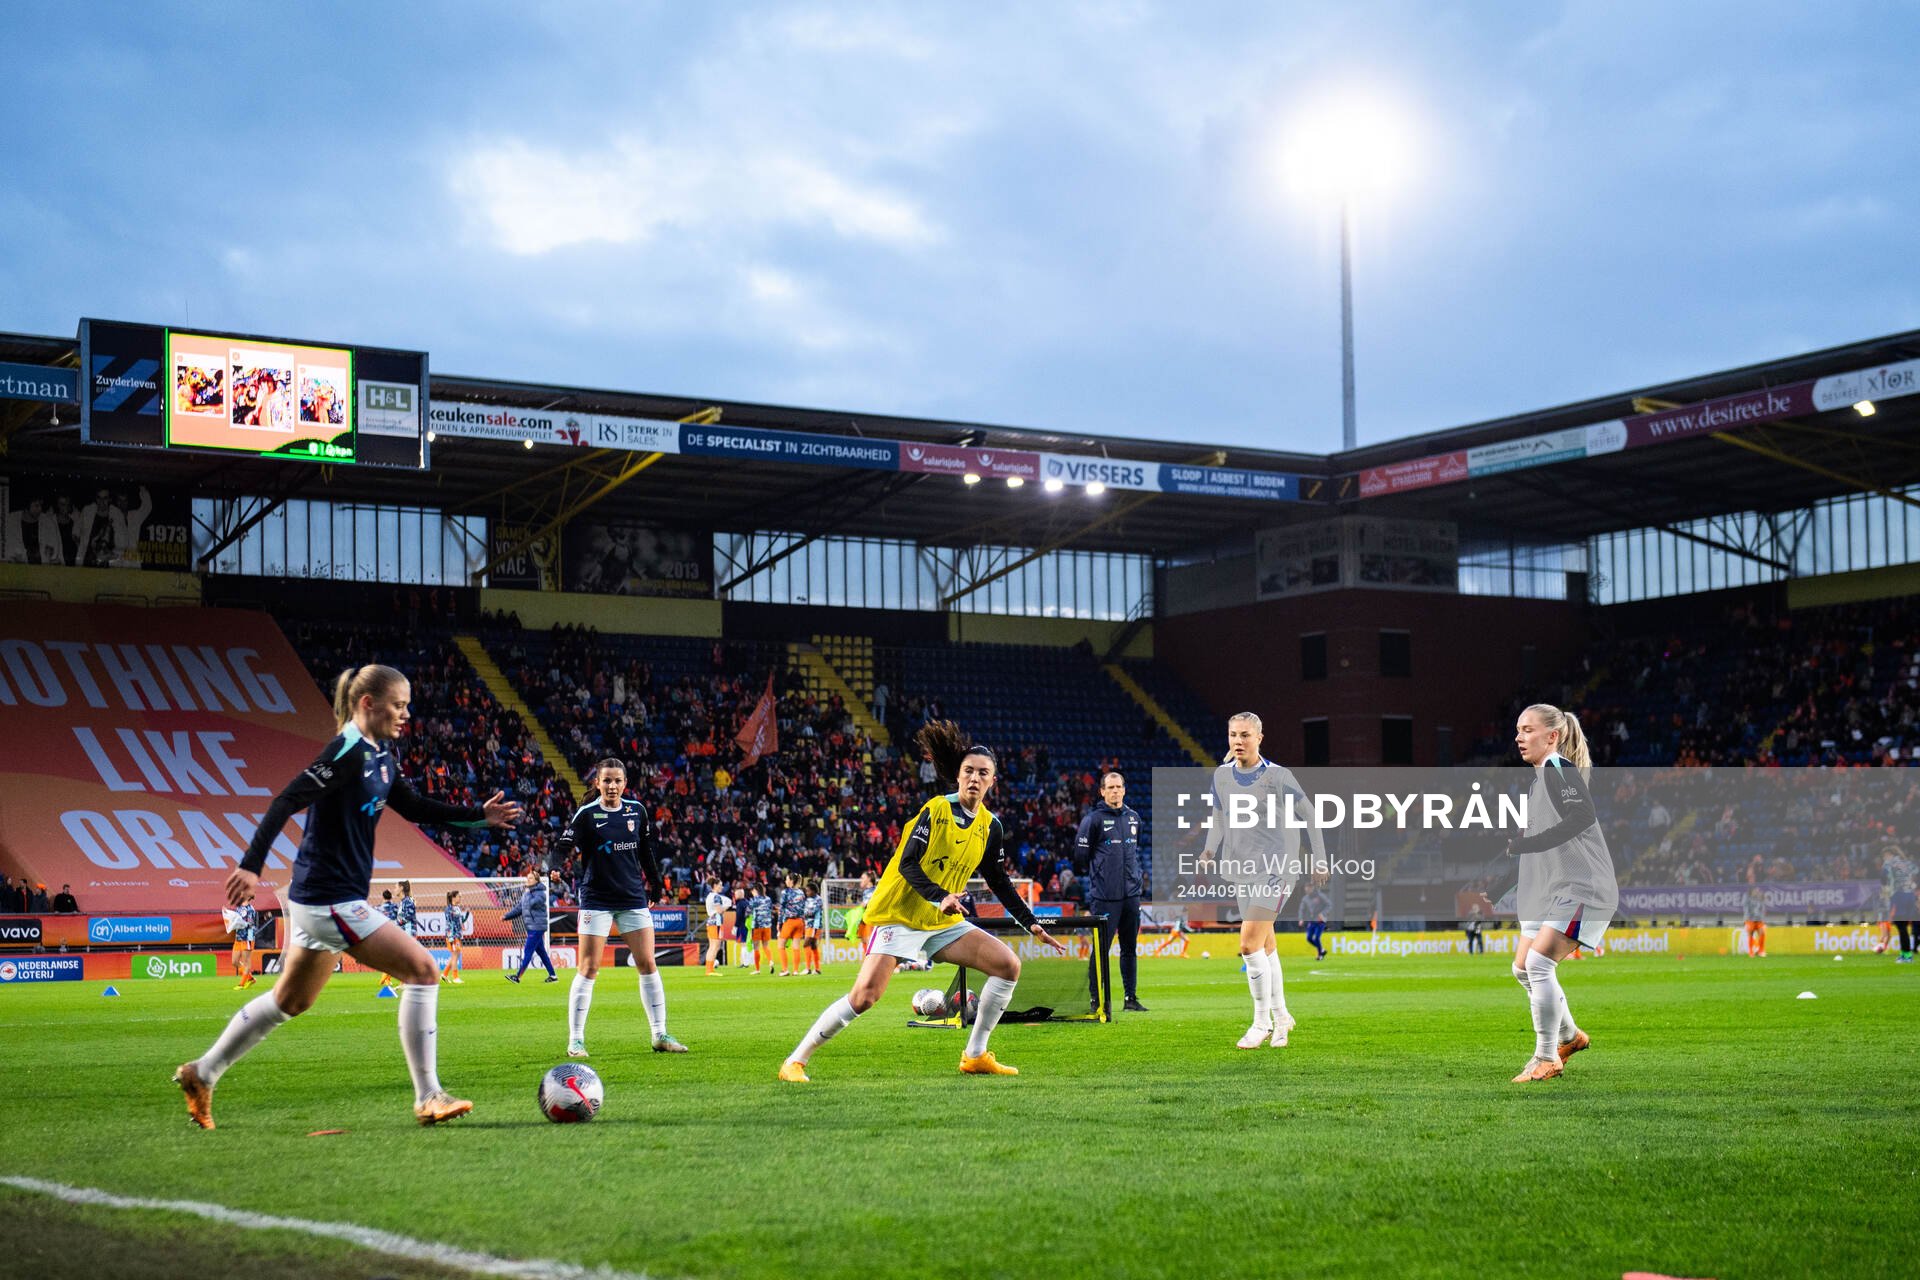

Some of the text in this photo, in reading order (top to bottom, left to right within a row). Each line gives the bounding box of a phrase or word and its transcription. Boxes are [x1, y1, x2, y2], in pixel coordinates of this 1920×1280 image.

[95, 375, 157, 390] Zuyderleven
[370, 388, 408, 409] H&L
[1648, 392, 1791, 437] www.desiree.be
[469, 426, 552, 440] APPARATUUROUTLET
[627, 425, 673, 438] STERK IN
[687, 433, 892, 462] DE SPECIALIST IN ZICHTBAARHEID
[1066, 462, 1144, 486] VISSERS
[1171, 468, 1286, 488] SLOOP ASBEST BODEM
[145, 524, 187, 543] 1973
[665, 561, 700, 580] 2013
[72, 727, 273, 797] LIKE
[1626, 886, 1845, 909] WOMEN'S EUROPEA QUALIFIERS
[114, 924, 143, 933] Albert
[145, 924, 169, 934] Heijn
[1332, 935, 1457, 957] Hoofdsponsor
[1609, 932, 1669, 953] voetbal
[18, 960, 79, 970] NEDERLANDSE
[18, 969, 54, 979] LOTERIJ
[169, 959, 203, 977] kpn
